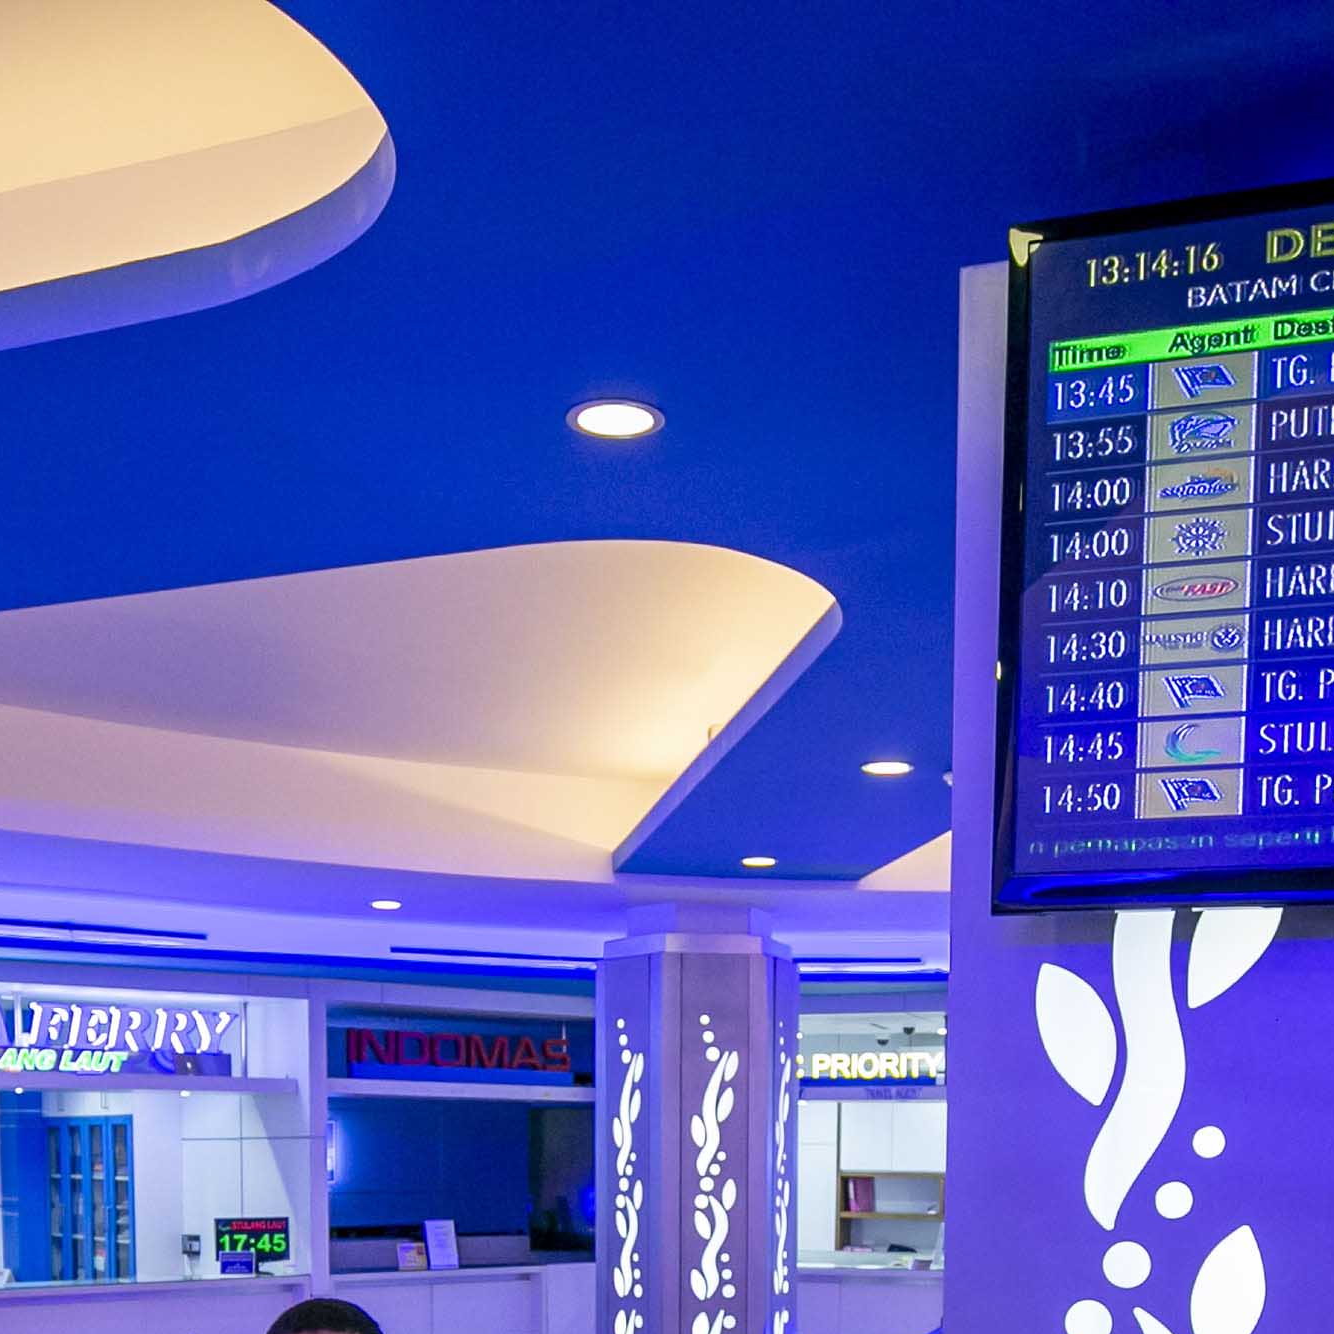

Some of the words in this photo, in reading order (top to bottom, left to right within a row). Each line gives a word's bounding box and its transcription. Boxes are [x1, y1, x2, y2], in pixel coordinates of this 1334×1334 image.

[1087, 243, 1221, 288] 13:14:16
[1187, 273, 1299, 309] BATAM
[1054, 344, 1124, 369] Time
[1168, 327, 1254, 355] Agent
[1054, 374, 1135, 410] 13:45
[1271, 354, 1315, 389] TG.
[1053, 426, 1133, 461] 13:55
[1052, 477, 1130, 512] 14:00
[1050, 528, 1129, 562] 14:00
[1049, 579, 1127, 613] 14:10
[1047, 630, 1126, 663] 14:30
[1045, 681, 1124, 714] 14:40
[1262, 669, 1304, 703] TG.
[1044, 731, 1123, 764] 14:45
[1042, 783, 1120, 814] 14:50
[1257, 774, 1300, 807] TG.
[28, 1001, 239, 1055] FERRY
[59, 1050, 129, 1073] LAUT
[347, 1027, 571, 1073] INDOMAS
[811, 1051, 946, 1080] PRIORITY
[219, 1233, 287, 1252] 17:45
